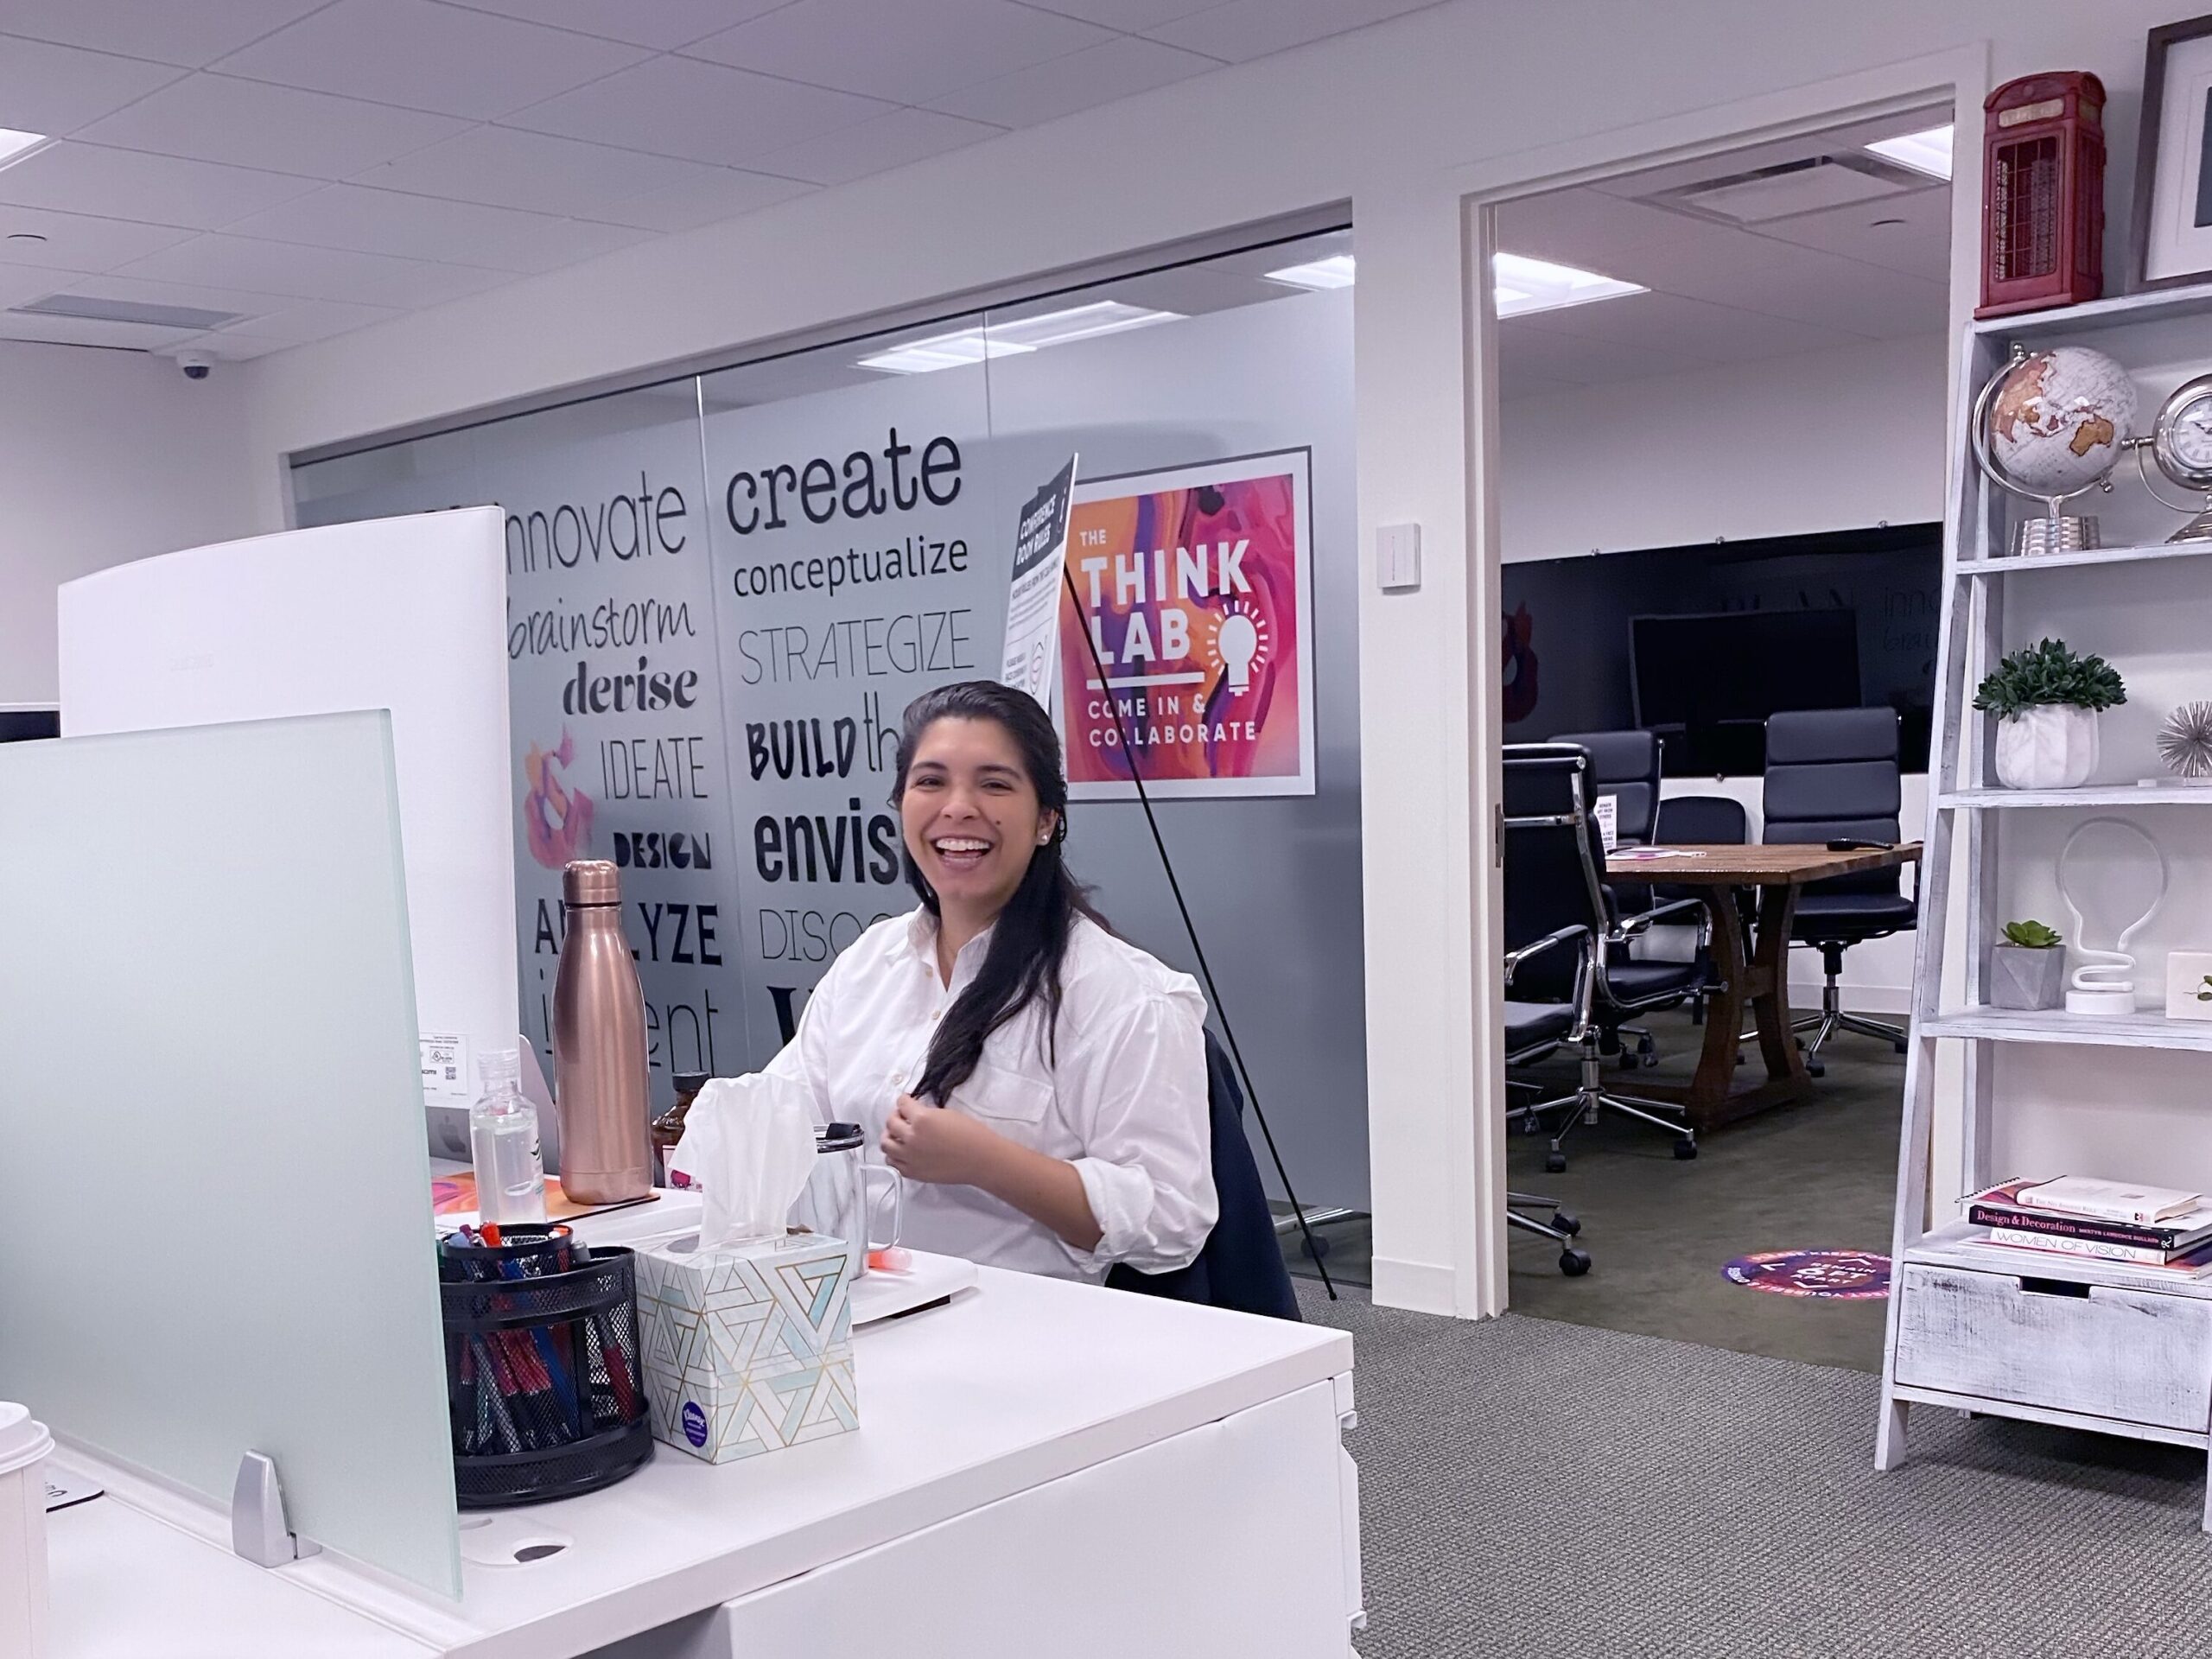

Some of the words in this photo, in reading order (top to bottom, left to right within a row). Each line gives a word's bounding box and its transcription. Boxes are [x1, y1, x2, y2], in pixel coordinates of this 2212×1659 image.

[727, 427, 962, 535] create
[493, 471, 687, 575] nnovate
[1079, 529, 1107, 547] THE
[734, 535, 969, 597] conceptualize
[1080, 538, 1252, 607] THINK
[505, 596, 696, 660] brainstorm
[738, 608, 975, 685] STRATEGIZE
[1091, 607, 1192, 666] LAB
[563, 655, 698, 715] devise
[1087, 697, 1147, 720] COME
[1158, 695, 1179, 715] IN
[1192, 693, 1206, 715] &
[746, 715, 856, 781] BUILD
[863, 691, 900, 772] th
[601, 736, 709, 800] IDEATE
[613, 831, 712, 870] DESIGN
[753, 797, 912, 886] envis
[1977, 1210, 2010, 1227] Design
[2012, 1215, 2020, 1225] &
[2022, 1216, 2075, 1233] Decoration
[1997, 1231, 2057, 1249] WOMEN
[2061, 1240, 2082, 1250] OF
[2086, 1243, 2136, 1259] VISION
[1789, 1274, 1853, 1284] APART
